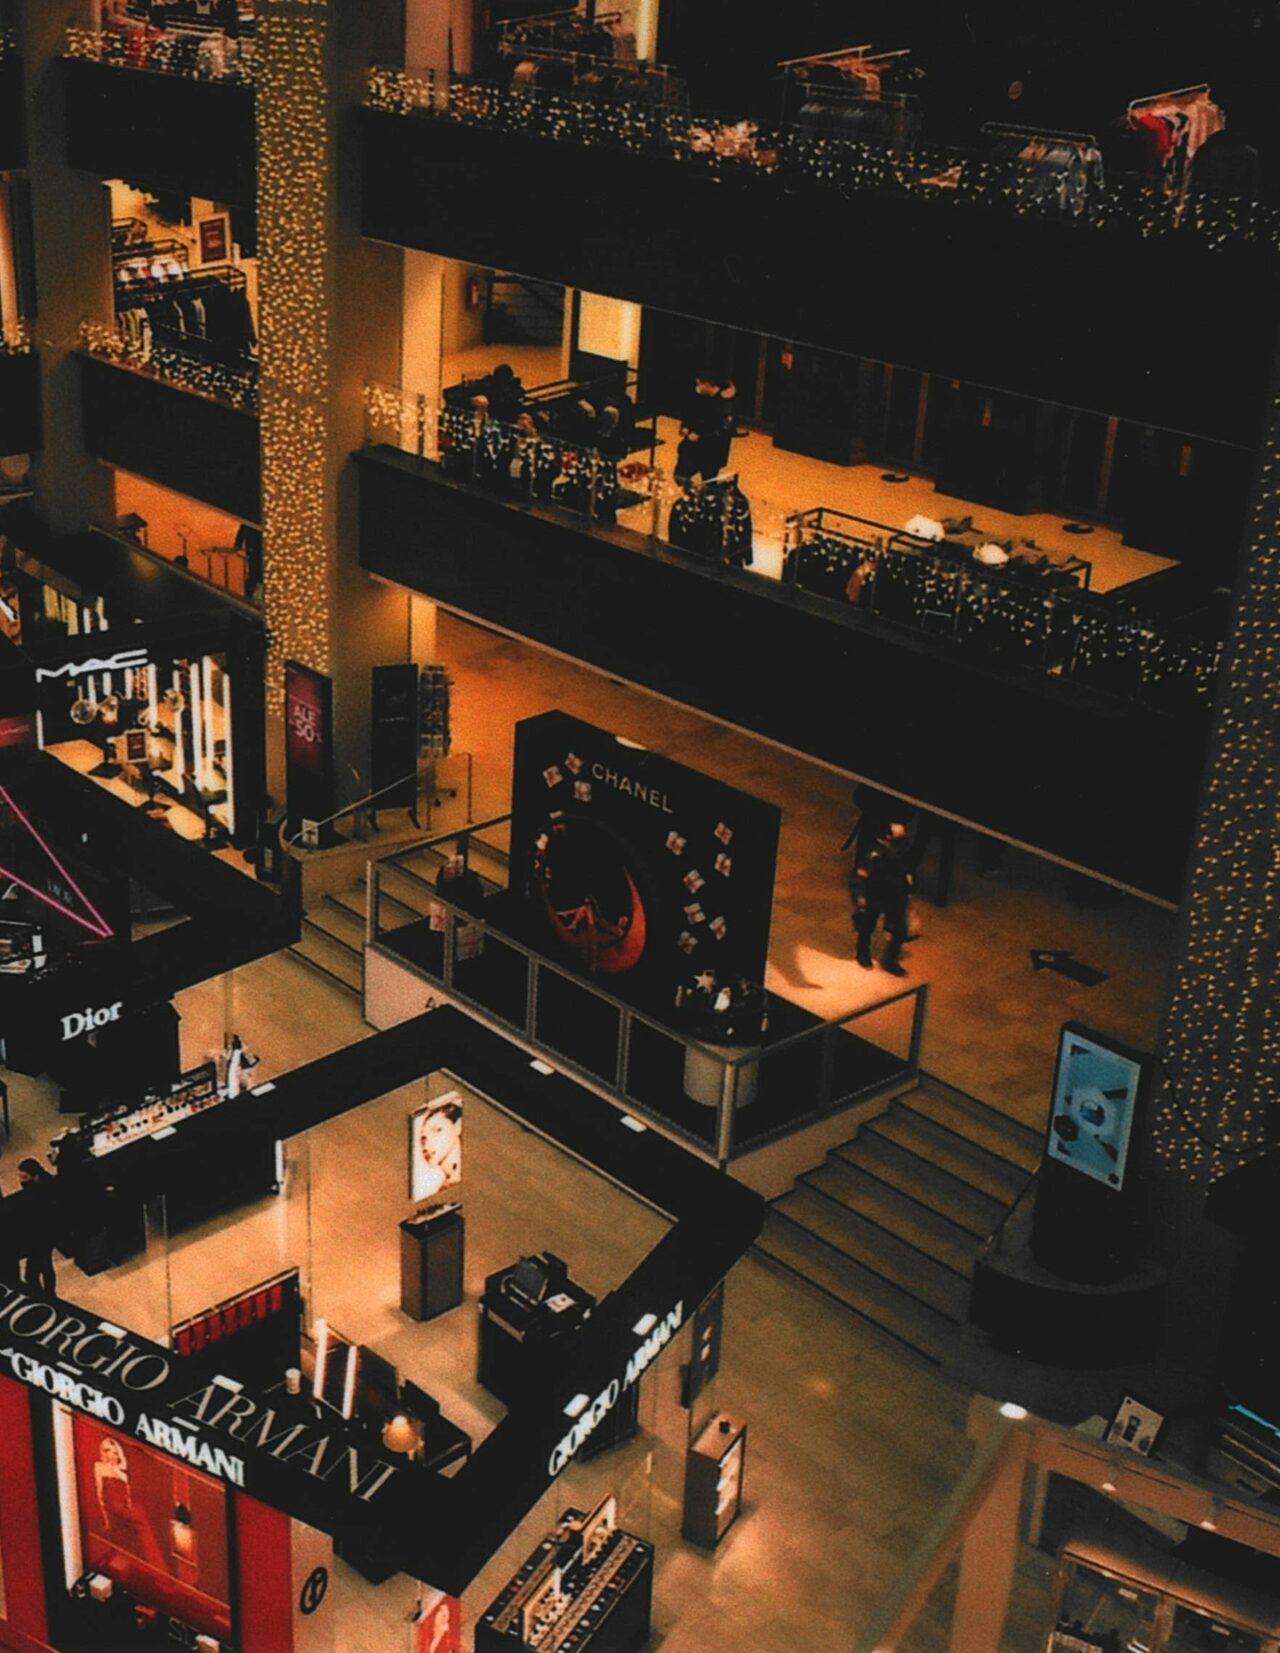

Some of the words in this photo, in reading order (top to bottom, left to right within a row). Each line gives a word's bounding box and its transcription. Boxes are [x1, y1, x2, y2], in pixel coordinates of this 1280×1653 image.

[591, 762, 673, 815] CHANEL
[60, 1001, 123, 1041] Dior
[10, 1352, 126, 1427] GIORGIO
[134, 1412, 246, 1489] ARMANI
[166, 1383, 400, 1503] ARMANI
